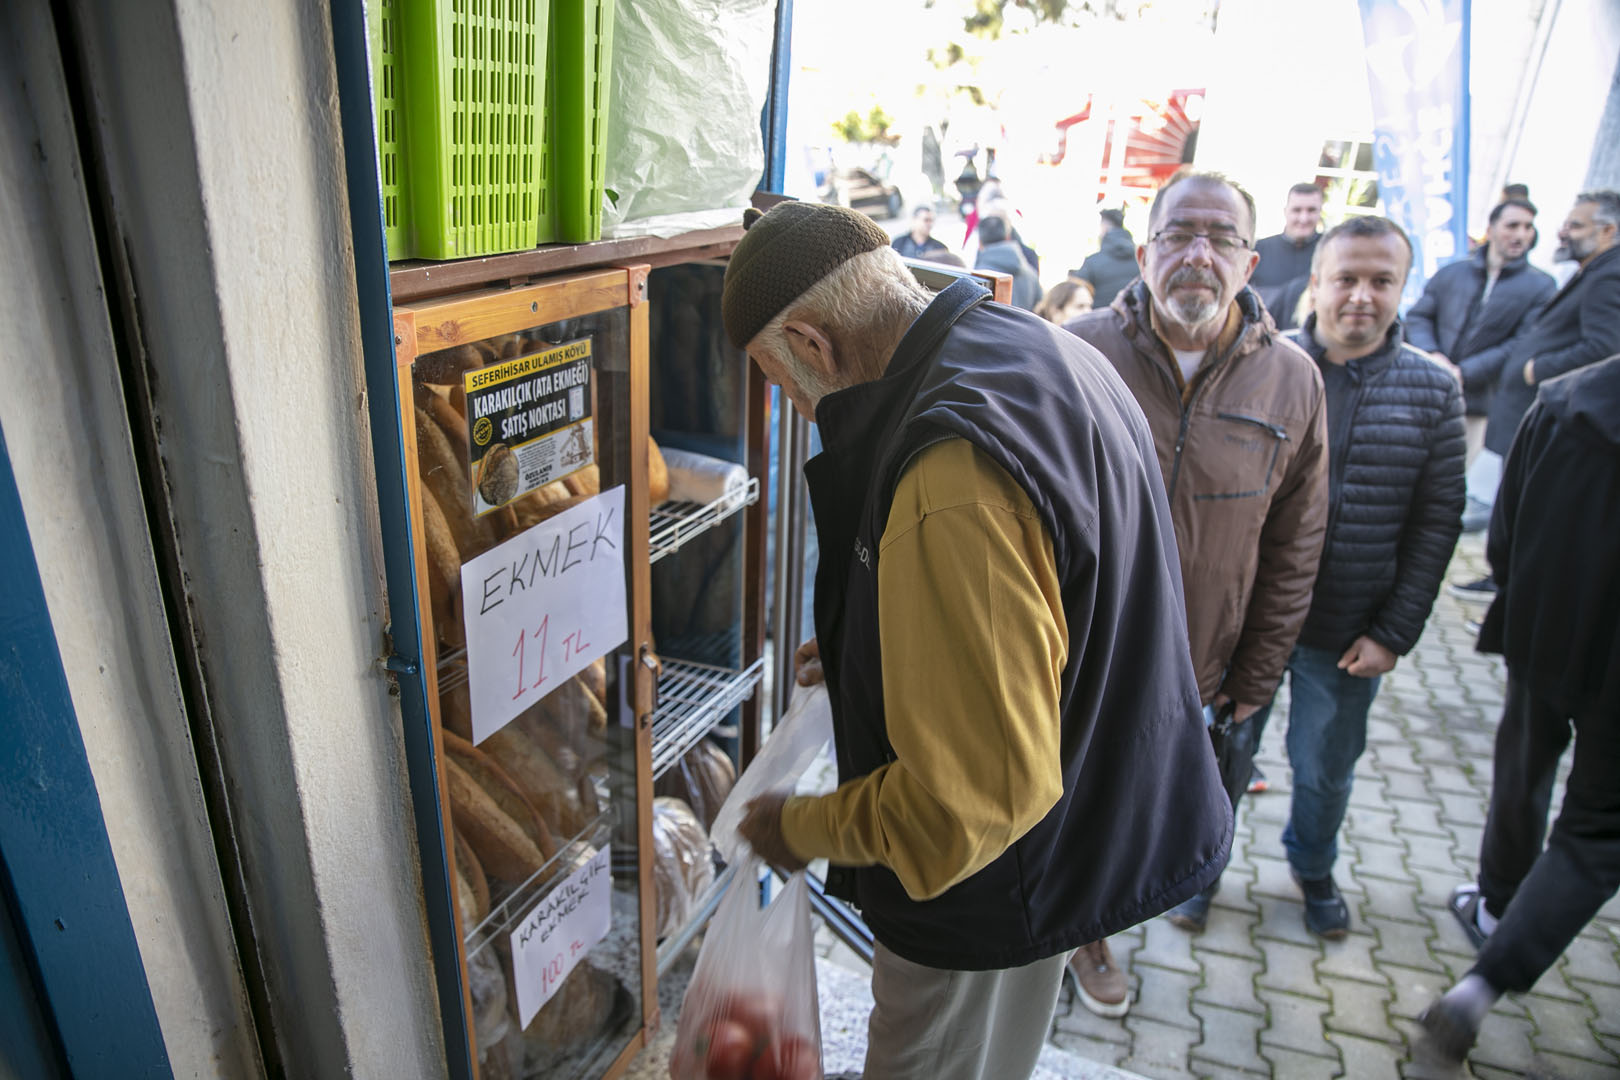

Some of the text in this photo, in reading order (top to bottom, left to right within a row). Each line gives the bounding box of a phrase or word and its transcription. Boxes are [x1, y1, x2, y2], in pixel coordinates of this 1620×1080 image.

[472, 343, 587, 387] SEFERİHİSAR ULAMIŞ KÖYÜ
[474, 360, 589, 419] KARAKILÇIK (ATA EKMEĞİ)
[501, 412, 527, 440] SATIŞ
[529, 398, 566, 429] NOKTASI
[480, 507, 616, 615] EKMEK
[512, 614, 591, 700] 11 TL
[540, 889, 590, 944] EKMEK
[541, 952, 564, 993] 100
